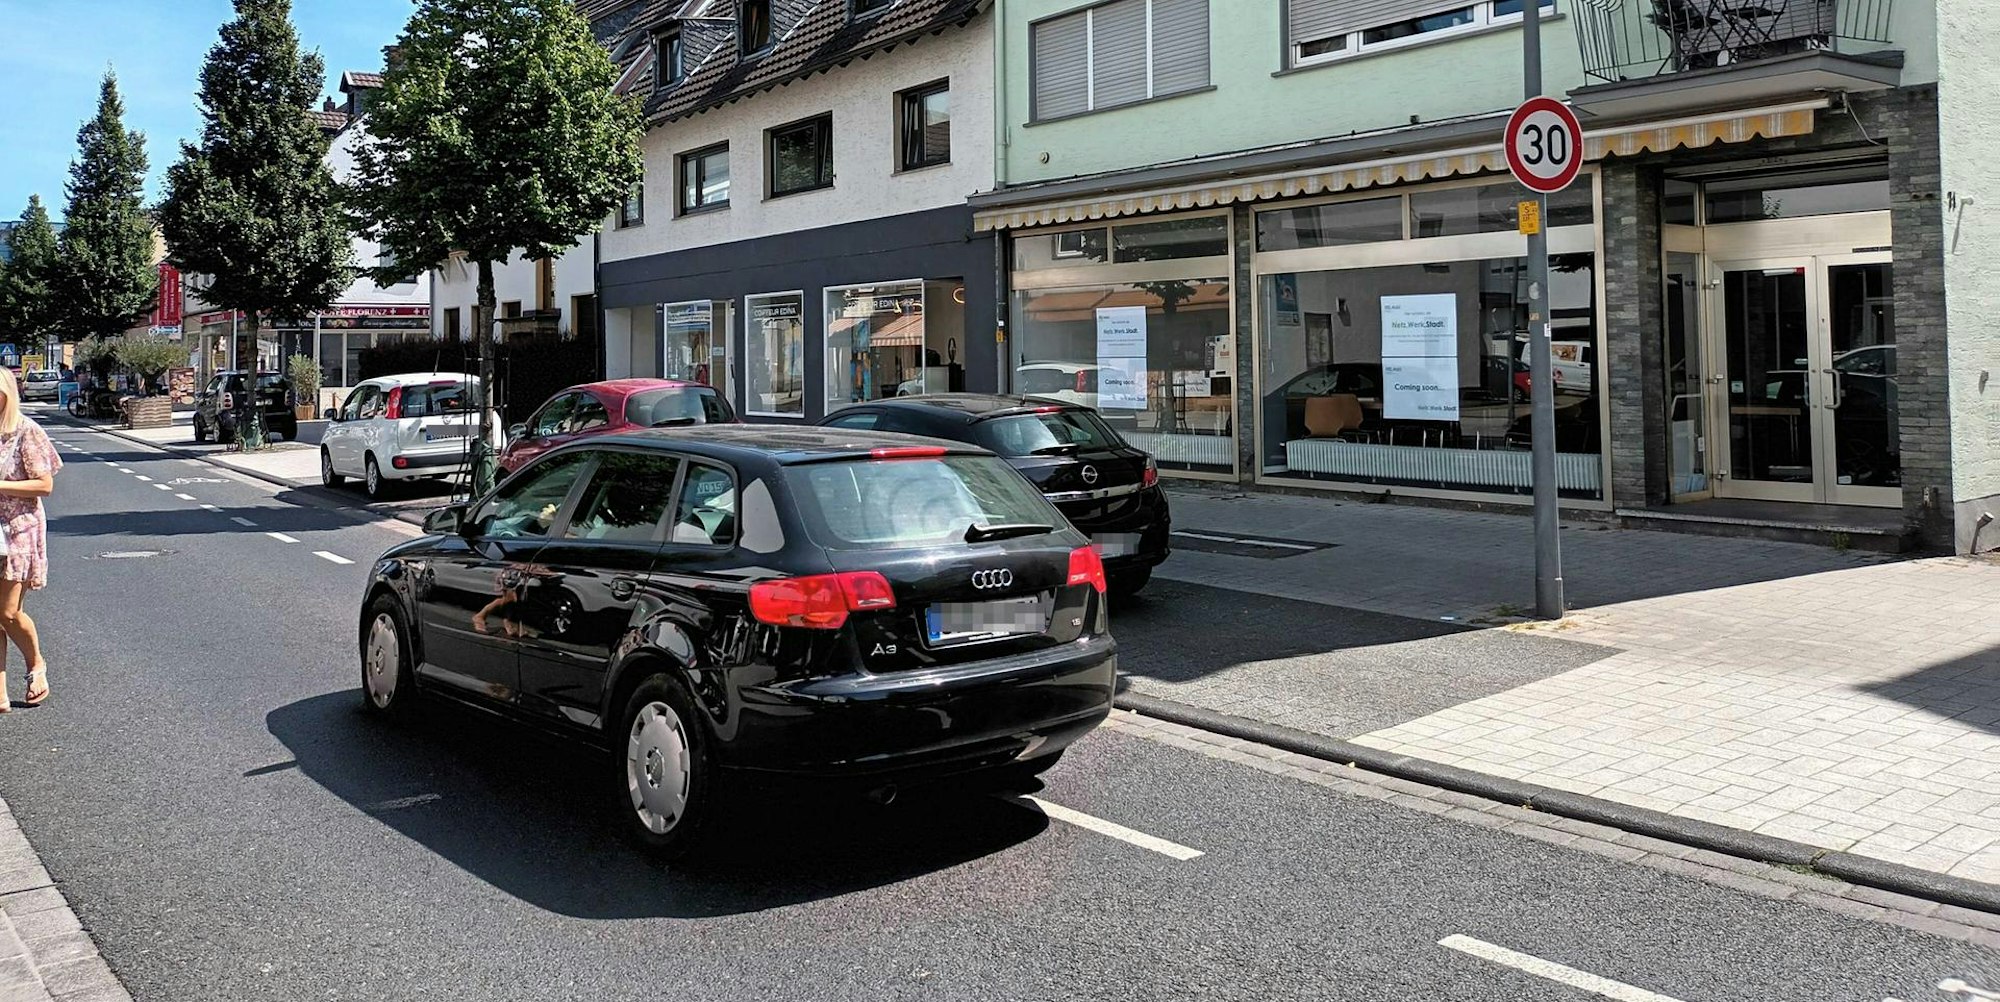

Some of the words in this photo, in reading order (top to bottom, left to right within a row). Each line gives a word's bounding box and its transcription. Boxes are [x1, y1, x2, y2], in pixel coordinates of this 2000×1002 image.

[1523, 124, 1566, 165] 30
[1394, 383, 1420, 392] Coming
[870, 643, 897, 656] A3
